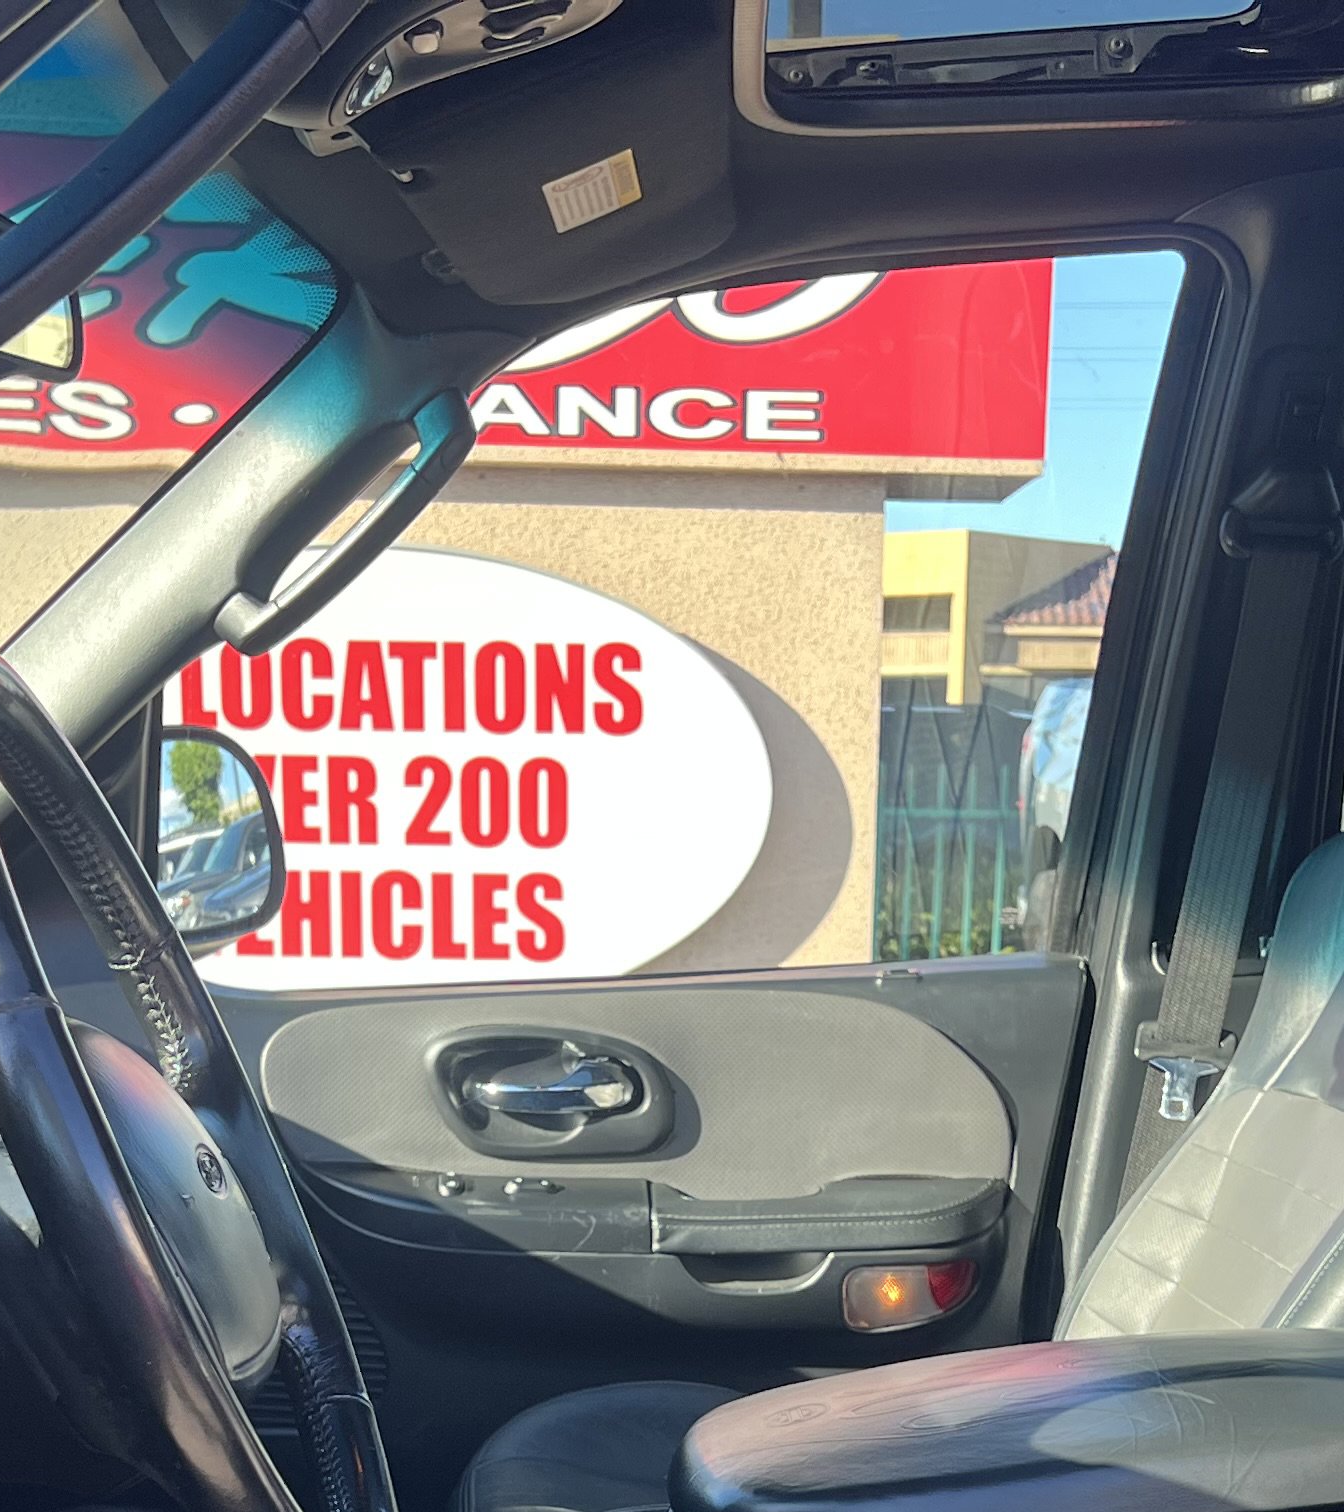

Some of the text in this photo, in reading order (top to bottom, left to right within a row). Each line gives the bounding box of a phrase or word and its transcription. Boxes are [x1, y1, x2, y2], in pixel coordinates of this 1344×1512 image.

[469, 383, 825, 442] ANCE
[180, 638, 644, 737] LOCATIONS
[254, 754, 570, 849] ER 200
[236, 869, 566, 963] HICLES
